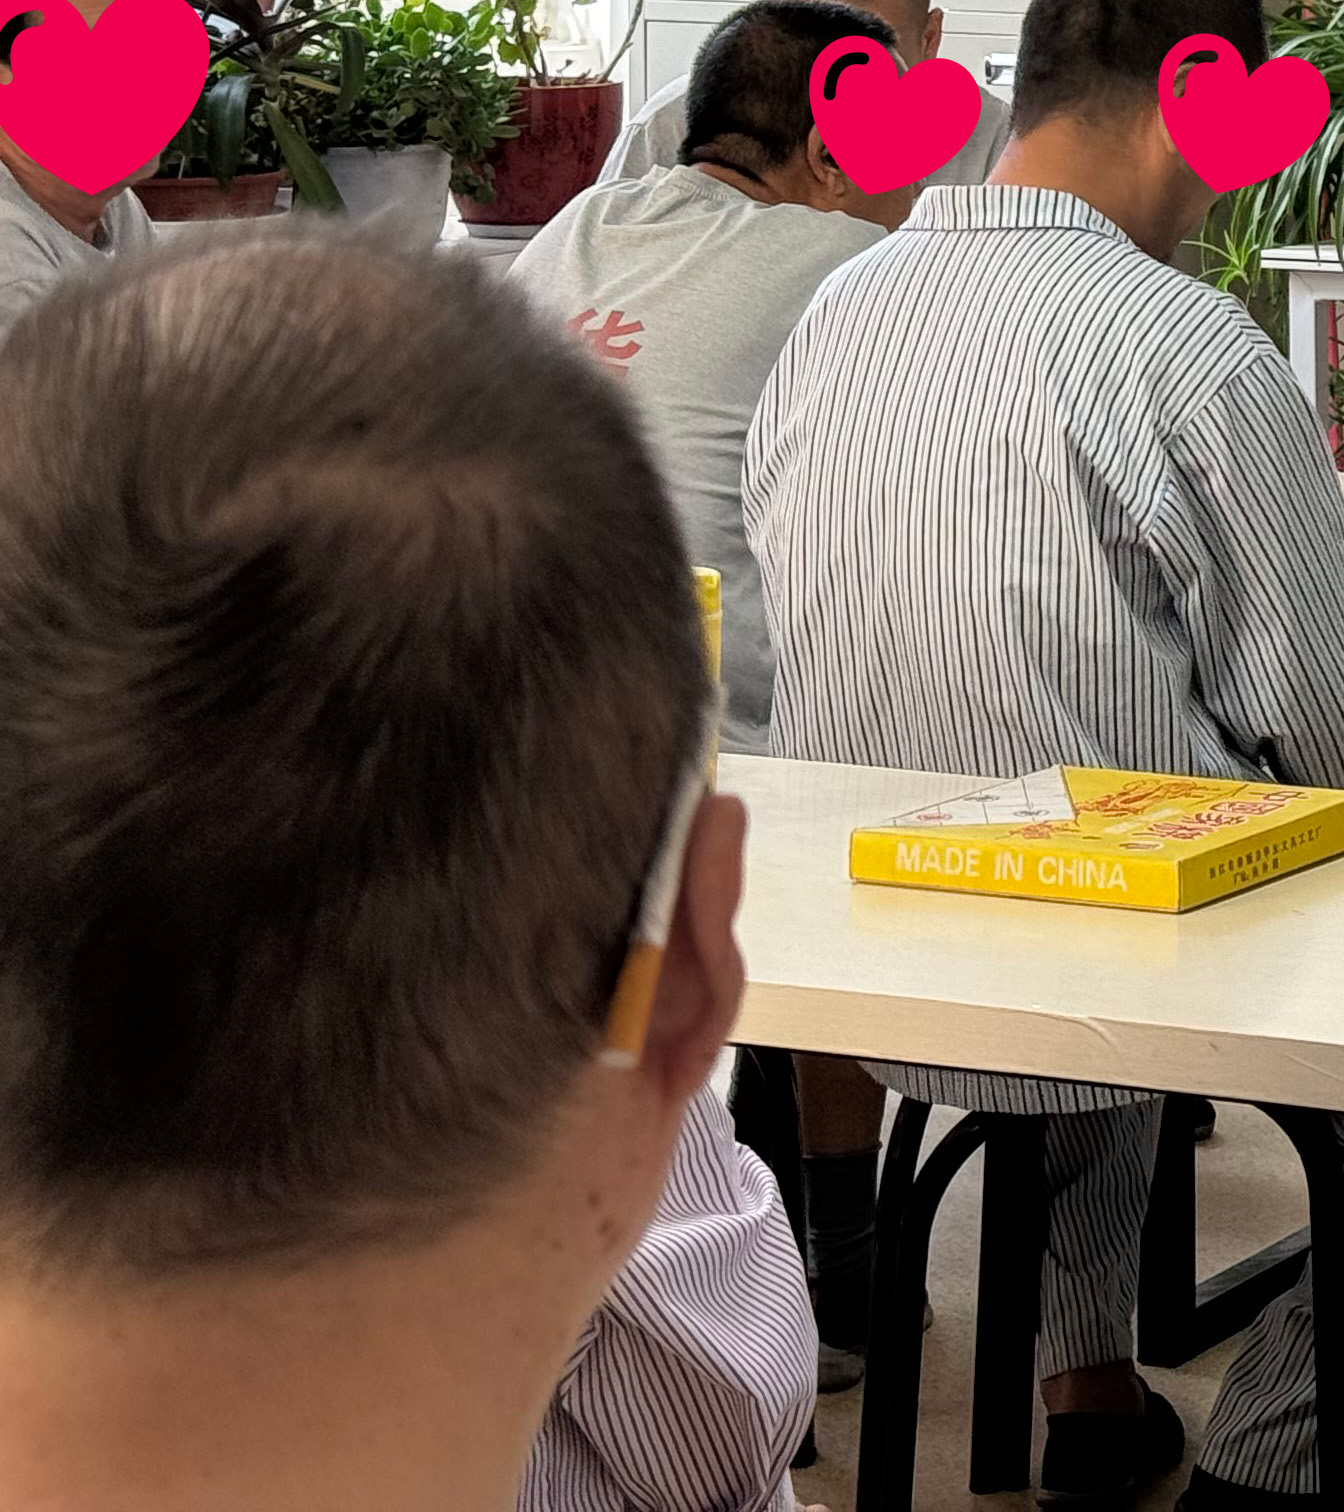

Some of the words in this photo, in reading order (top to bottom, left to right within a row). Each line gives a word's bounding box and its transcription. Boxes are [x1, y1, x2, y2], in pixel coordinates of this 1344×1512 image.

[895, 842, 981, 877] MADE
[993, 851, 1025, 882] IN
[1037, 855, 1128, 893] CHINA
